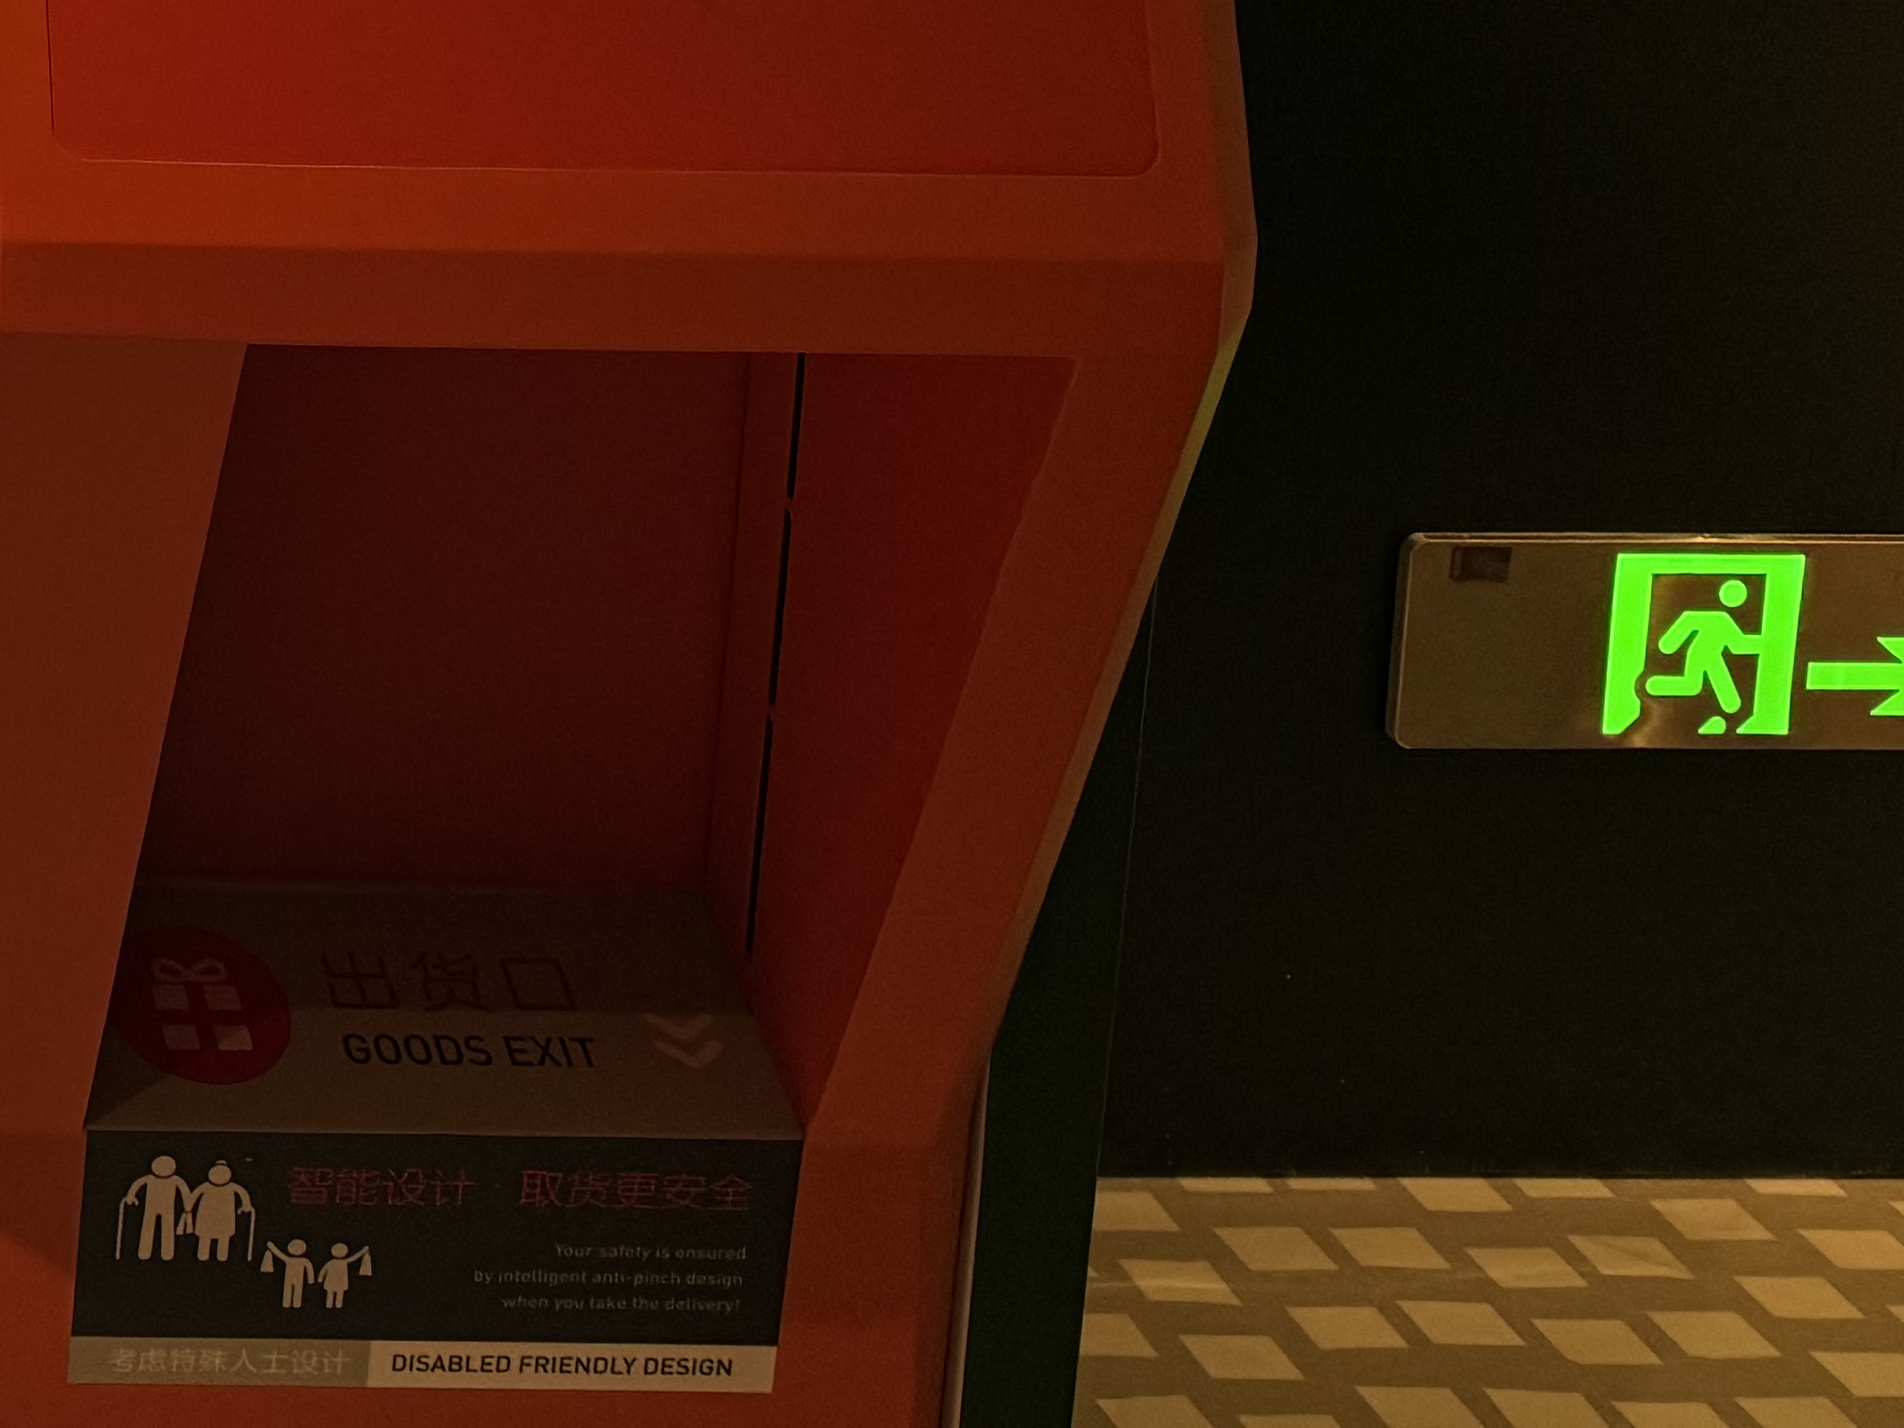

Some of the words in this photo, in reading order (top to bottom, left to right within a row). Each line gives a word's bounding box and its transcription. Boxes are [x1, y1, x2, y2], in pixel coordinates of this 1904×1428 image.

[319, 950, 580, 1013] 出货口
[342, 1032, 493, 1066] GOODS
[502, 1034, 596, 1068] EXIT
[288, 1166, 478, 1208] 智能设计
[519, 1169, 754, 1212] 取货更安全
[555, 1243, 592, 1258] Your
[598, 1244, 650, 1261] safety
[655, 1245, 670, 1259] is
[675, 1246, 747, 1260] ensured
[473, 1270, 493, 1284] by
[498, 1270, 587, 1287] intelligent
[592, 1271, 681, 1287] anti-pinch
[686, 1272, 743, 1289] design
[502, 1295, 549, 1309] when
[555, 1297, 584, 1312] you
[589, 1297, 627, 1310] take
[632, 1297, 659, 1311] the
[108, 1346, 350, 1376] 考虑特殊人士设计
[391, 1353, 512, 1374] DISABLED
[518, 1355, 638, 1376] FRIENDLY
[643, 1357, 734, 1377] DESIGN
